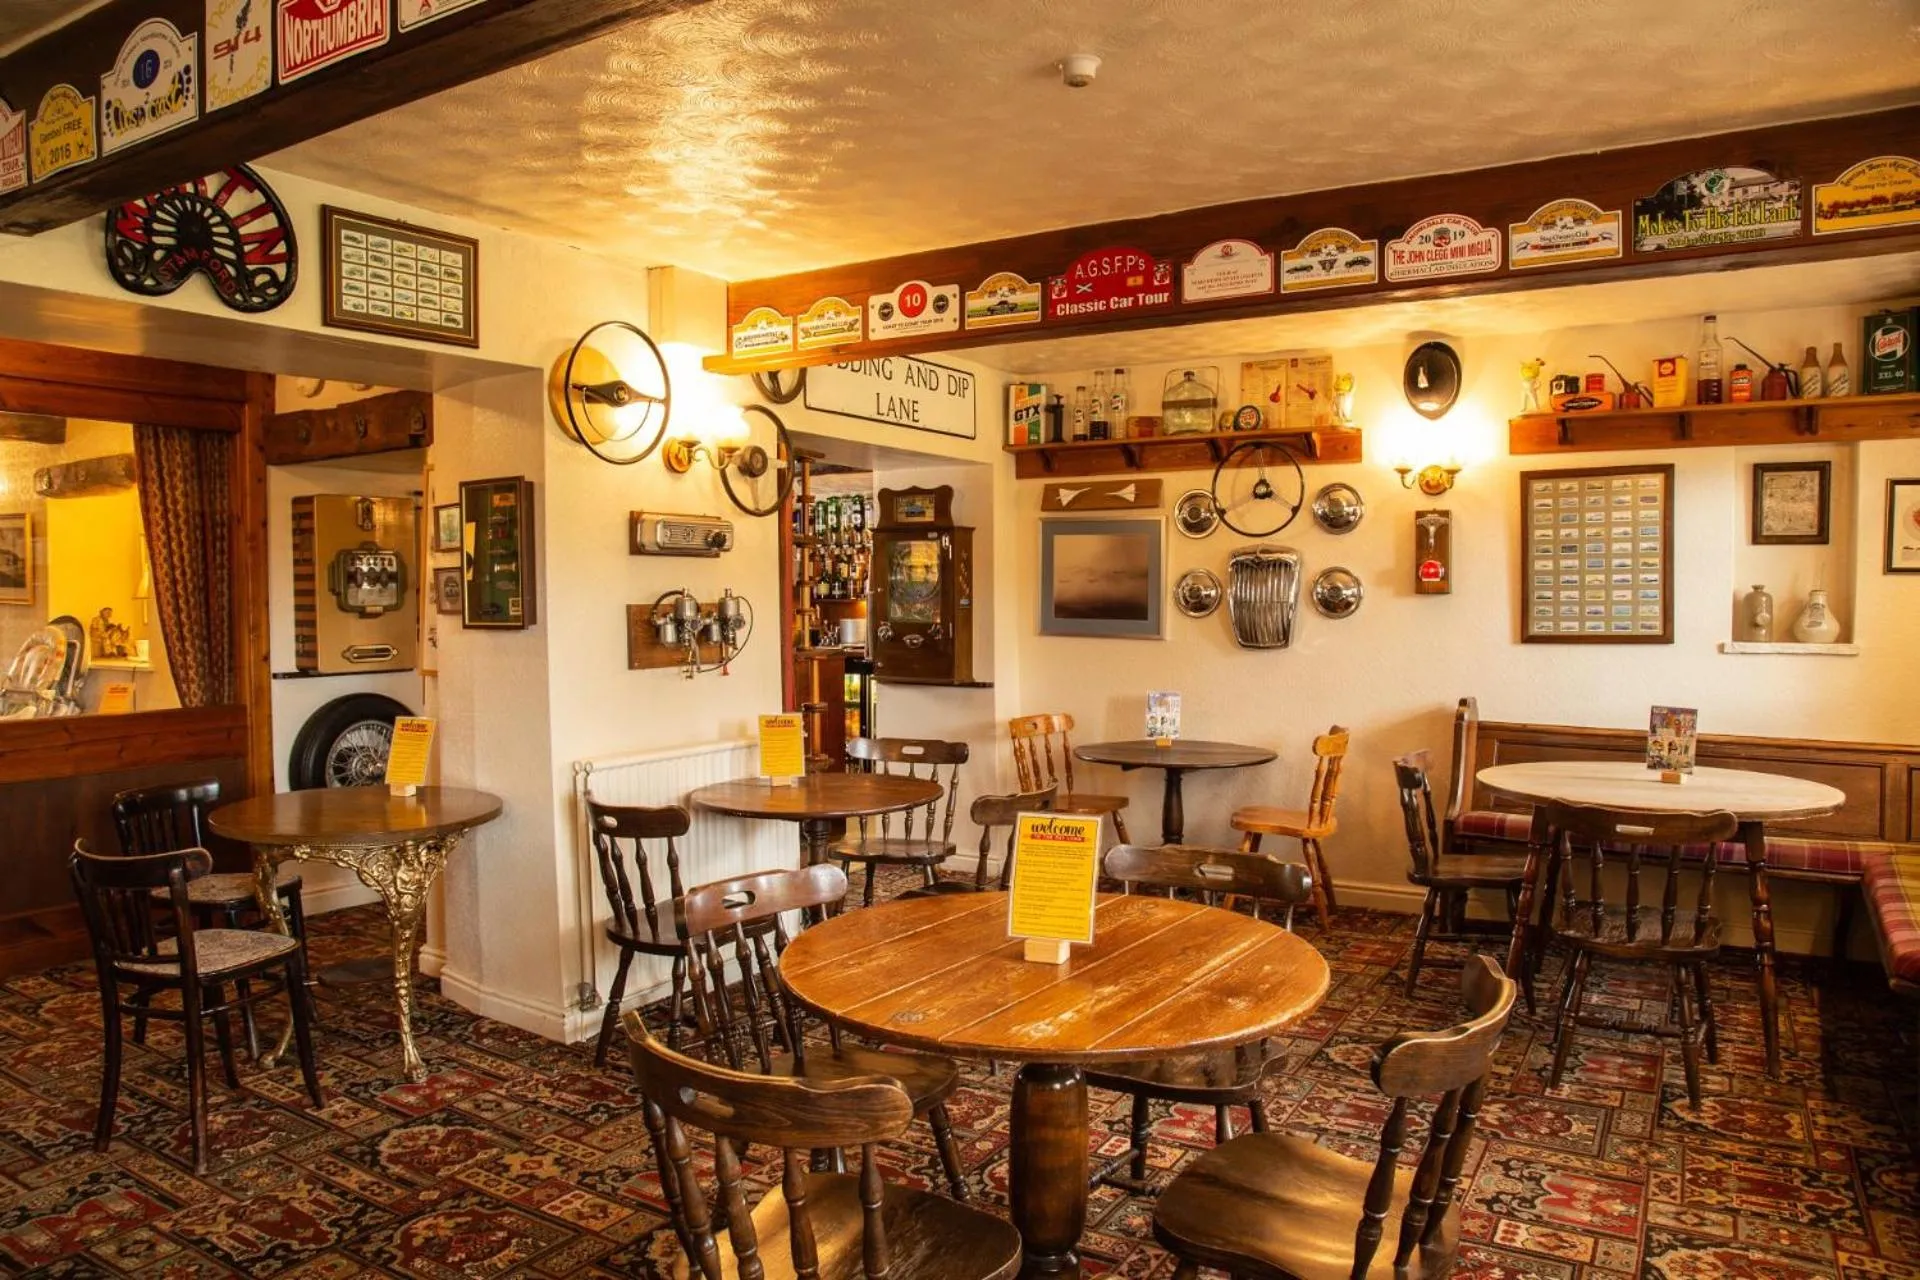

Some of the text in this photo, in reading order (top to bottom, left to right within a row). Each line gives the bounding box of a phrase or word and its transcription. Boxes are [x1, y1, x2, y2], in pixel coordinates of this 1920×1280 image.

[285, 0, 382, 69] NORTHUMBRIA
[63, 118, 83, 133] FREE
[1638, 196, 1798, 236] Mokes To The Fat Lamb
[1418, 230, 1466, 245] 20 19
[1393, 249, 1406, 266] THE
[1407, 249, 1426, 264] JOHN
[1426, 247, 1449, 262] CLEGG
[1450, 244, 1467, 260] MINI
[1467, 238, 1493, 258] MIGLIA
[905, 292, 921, 308] 10
[1056, 292, 1170, 316] Classic Car Tour
[904, 363, 940, 392] AND
[947, 374, 970, 399] DIP
[876, 392, 920, 423] LANE
[1014, 403, 1041, 422] GTX
[1031, 818, 1085, 837] welcome
